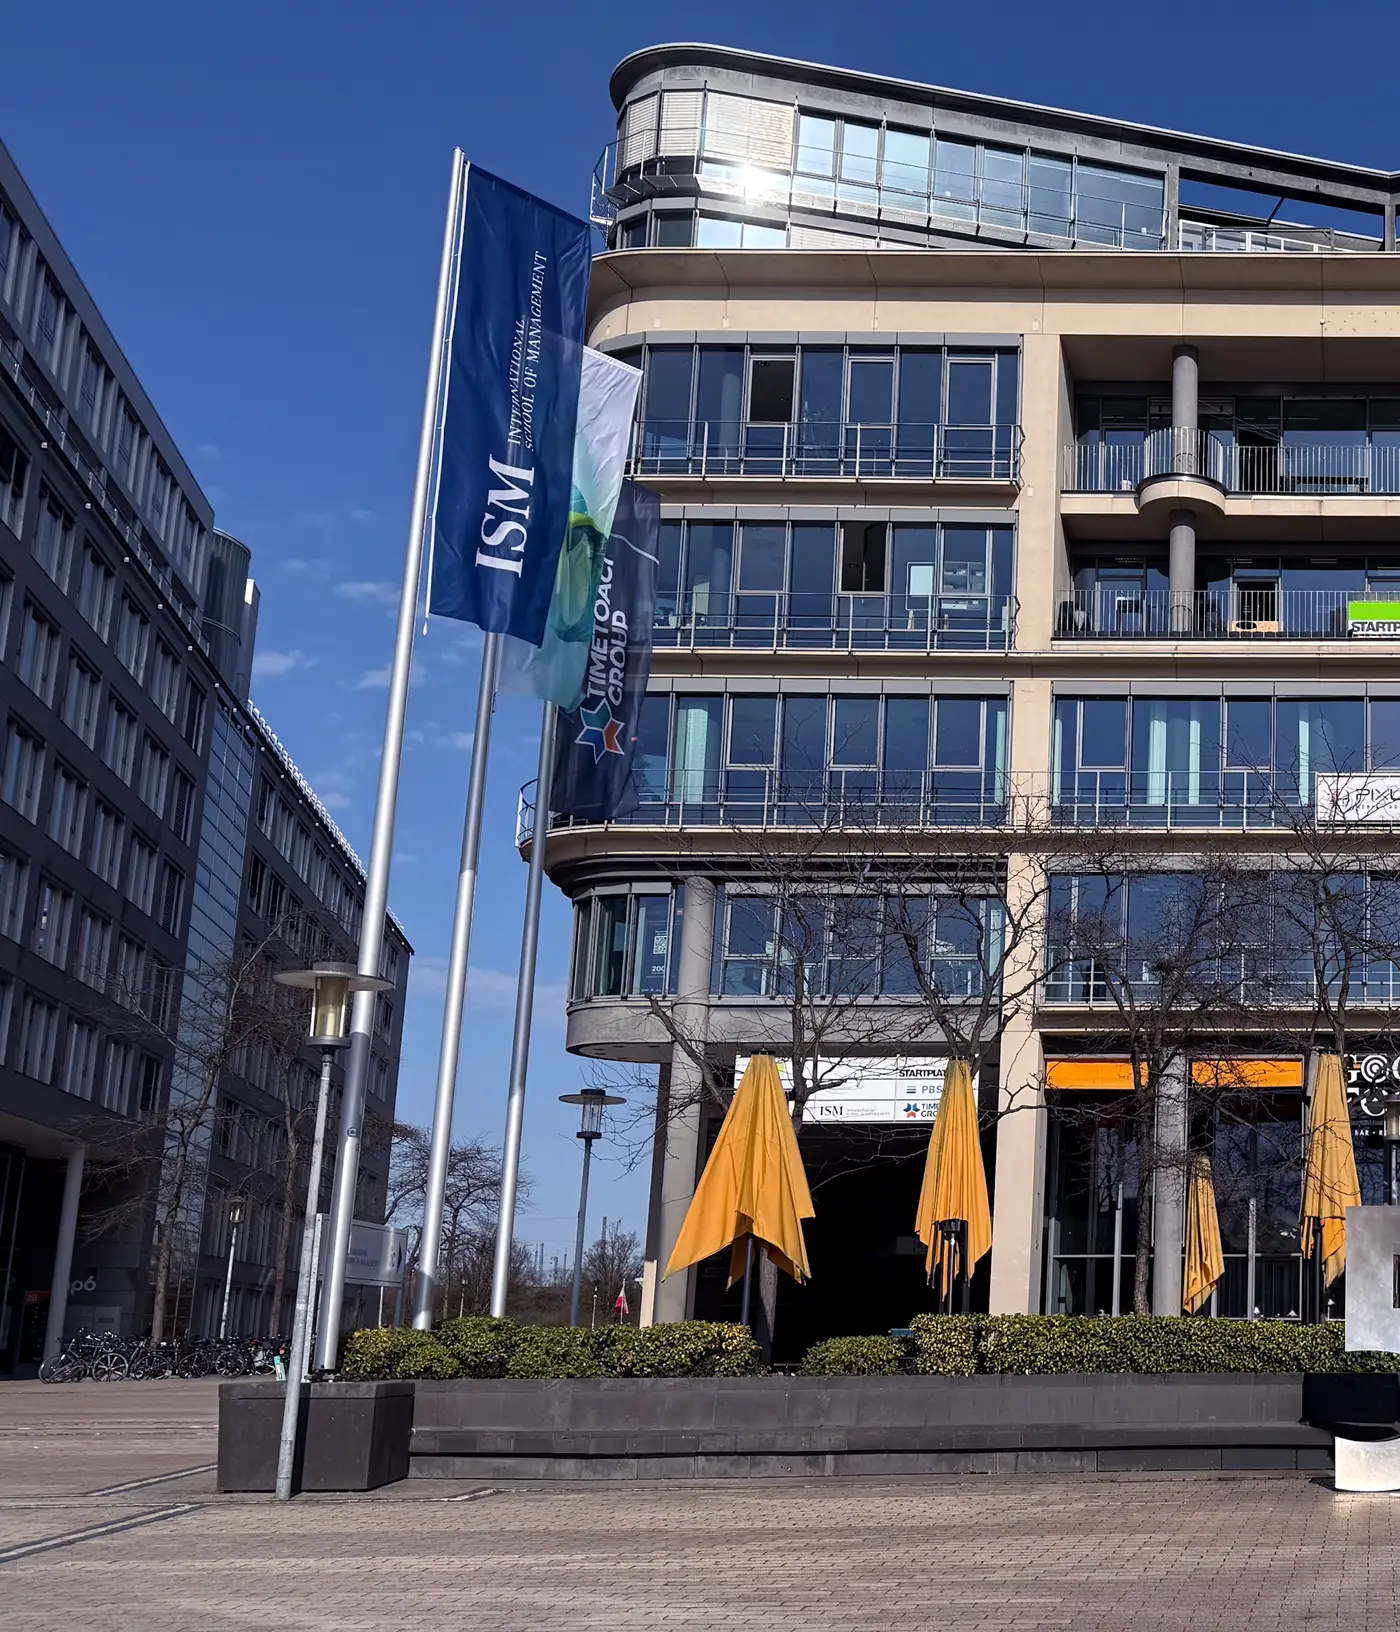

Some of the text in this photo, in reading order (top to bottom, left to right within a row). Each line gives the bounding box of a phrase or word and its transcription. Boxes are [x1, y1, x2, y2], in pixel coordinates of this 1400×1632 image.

[507, 319, 526, 445] INTERNATIONAL
[521, 250, 548, 452] SCHOOL OF MANAGEMENT
[475, 454, 535, 578] ISM
[607, 610, 629, 706] GROUP
[819, 1106, 843, 1116] ISM
[899, 1069, 946, 1078] STARTPLAT
